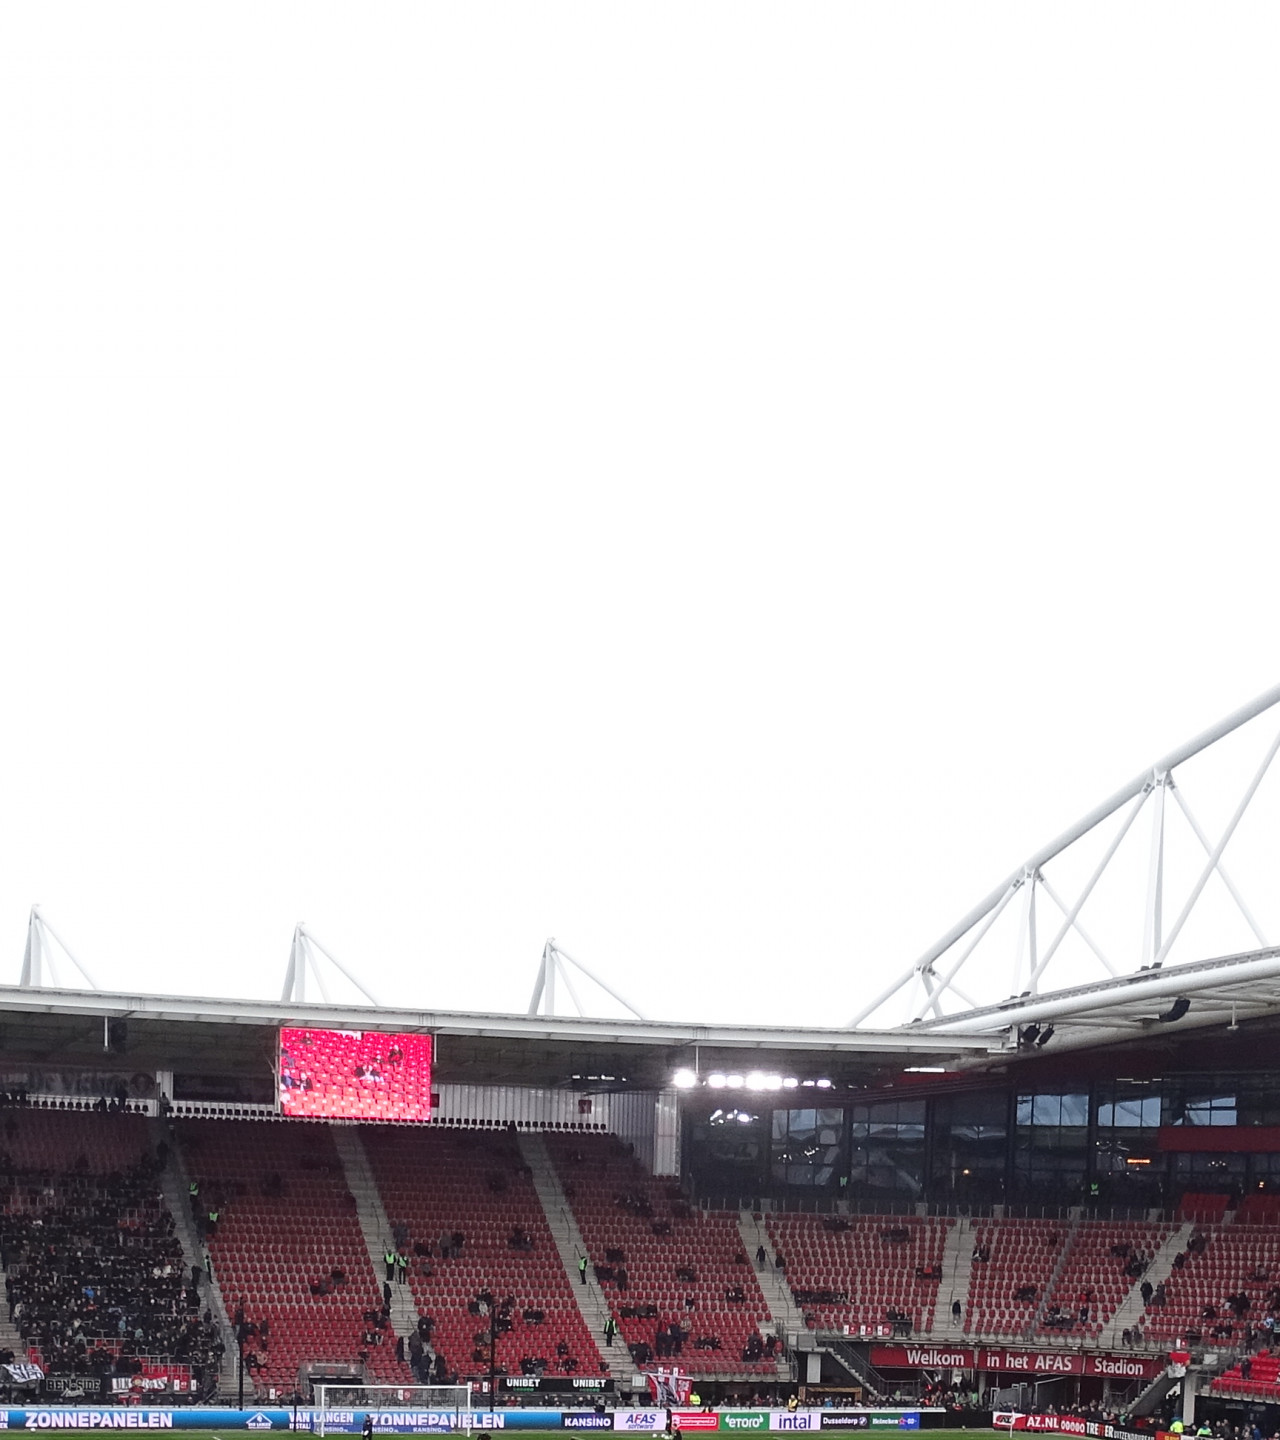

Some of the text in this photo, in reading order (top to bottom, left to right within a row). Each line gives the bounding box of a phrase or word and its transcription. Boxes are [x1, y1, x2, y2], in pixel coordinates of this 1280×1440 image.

[907, 1350, 964, 1366] Welkom
[987, 1353, 1072, 1371] in het AFAS
[1094, 1358, 1143, 1375] Stadion
[506, 1378, 540, 1387] UNIBET
[572, 1379, 606, 1388] UNIBET
[25, 1411, 173, 1428] ZONNEPANELEN
[288, 1412, 354, 1423] VAN LANGEN
[370, 1413, 505, 1429] ZONNEPANELEN
[564, 1416, 611, 1427] KANSINO
[625, 1413, 657, 1424] AFAS
[779, 1414, 811, 1429] intal
[823, 1417, 858, 1426] Dusseldorp
[1027, 1416, 1059, 1428] AZ.NL
